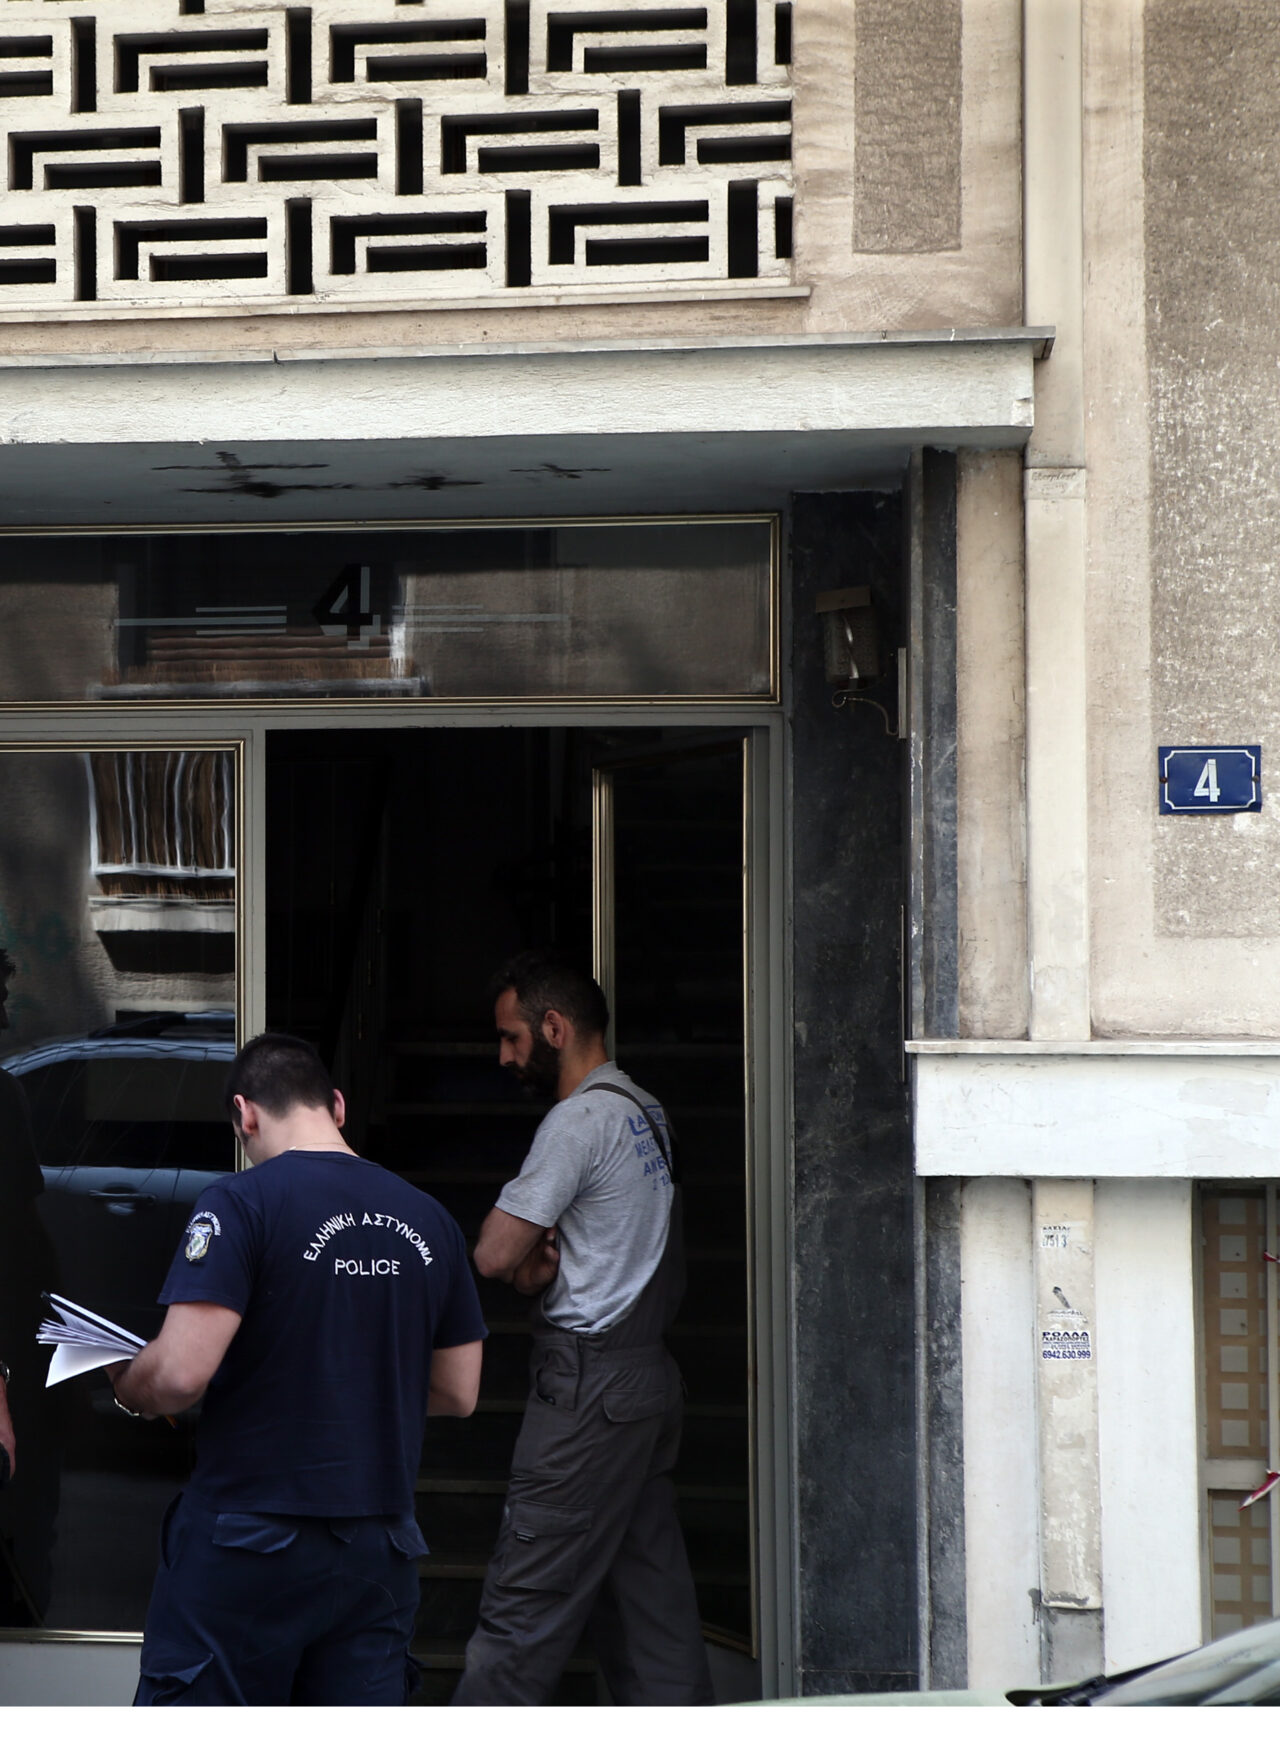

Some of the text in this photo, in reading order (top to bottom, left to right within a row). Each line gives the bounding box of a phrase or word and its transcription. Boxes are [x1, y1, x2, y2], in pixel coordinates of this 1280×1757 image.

[312, 562, 380, 650] 4
[1193, 758, 1220, 803] 4
[303, 1212, 434, 1267] ΕΛΛΗΝΙΚΗ ΑΣΤΥΝΟΜΙΑ
[335, 1258, 401, 1277] POLICE
[1042, 1350, 1091, 1360] 6942.630.999
